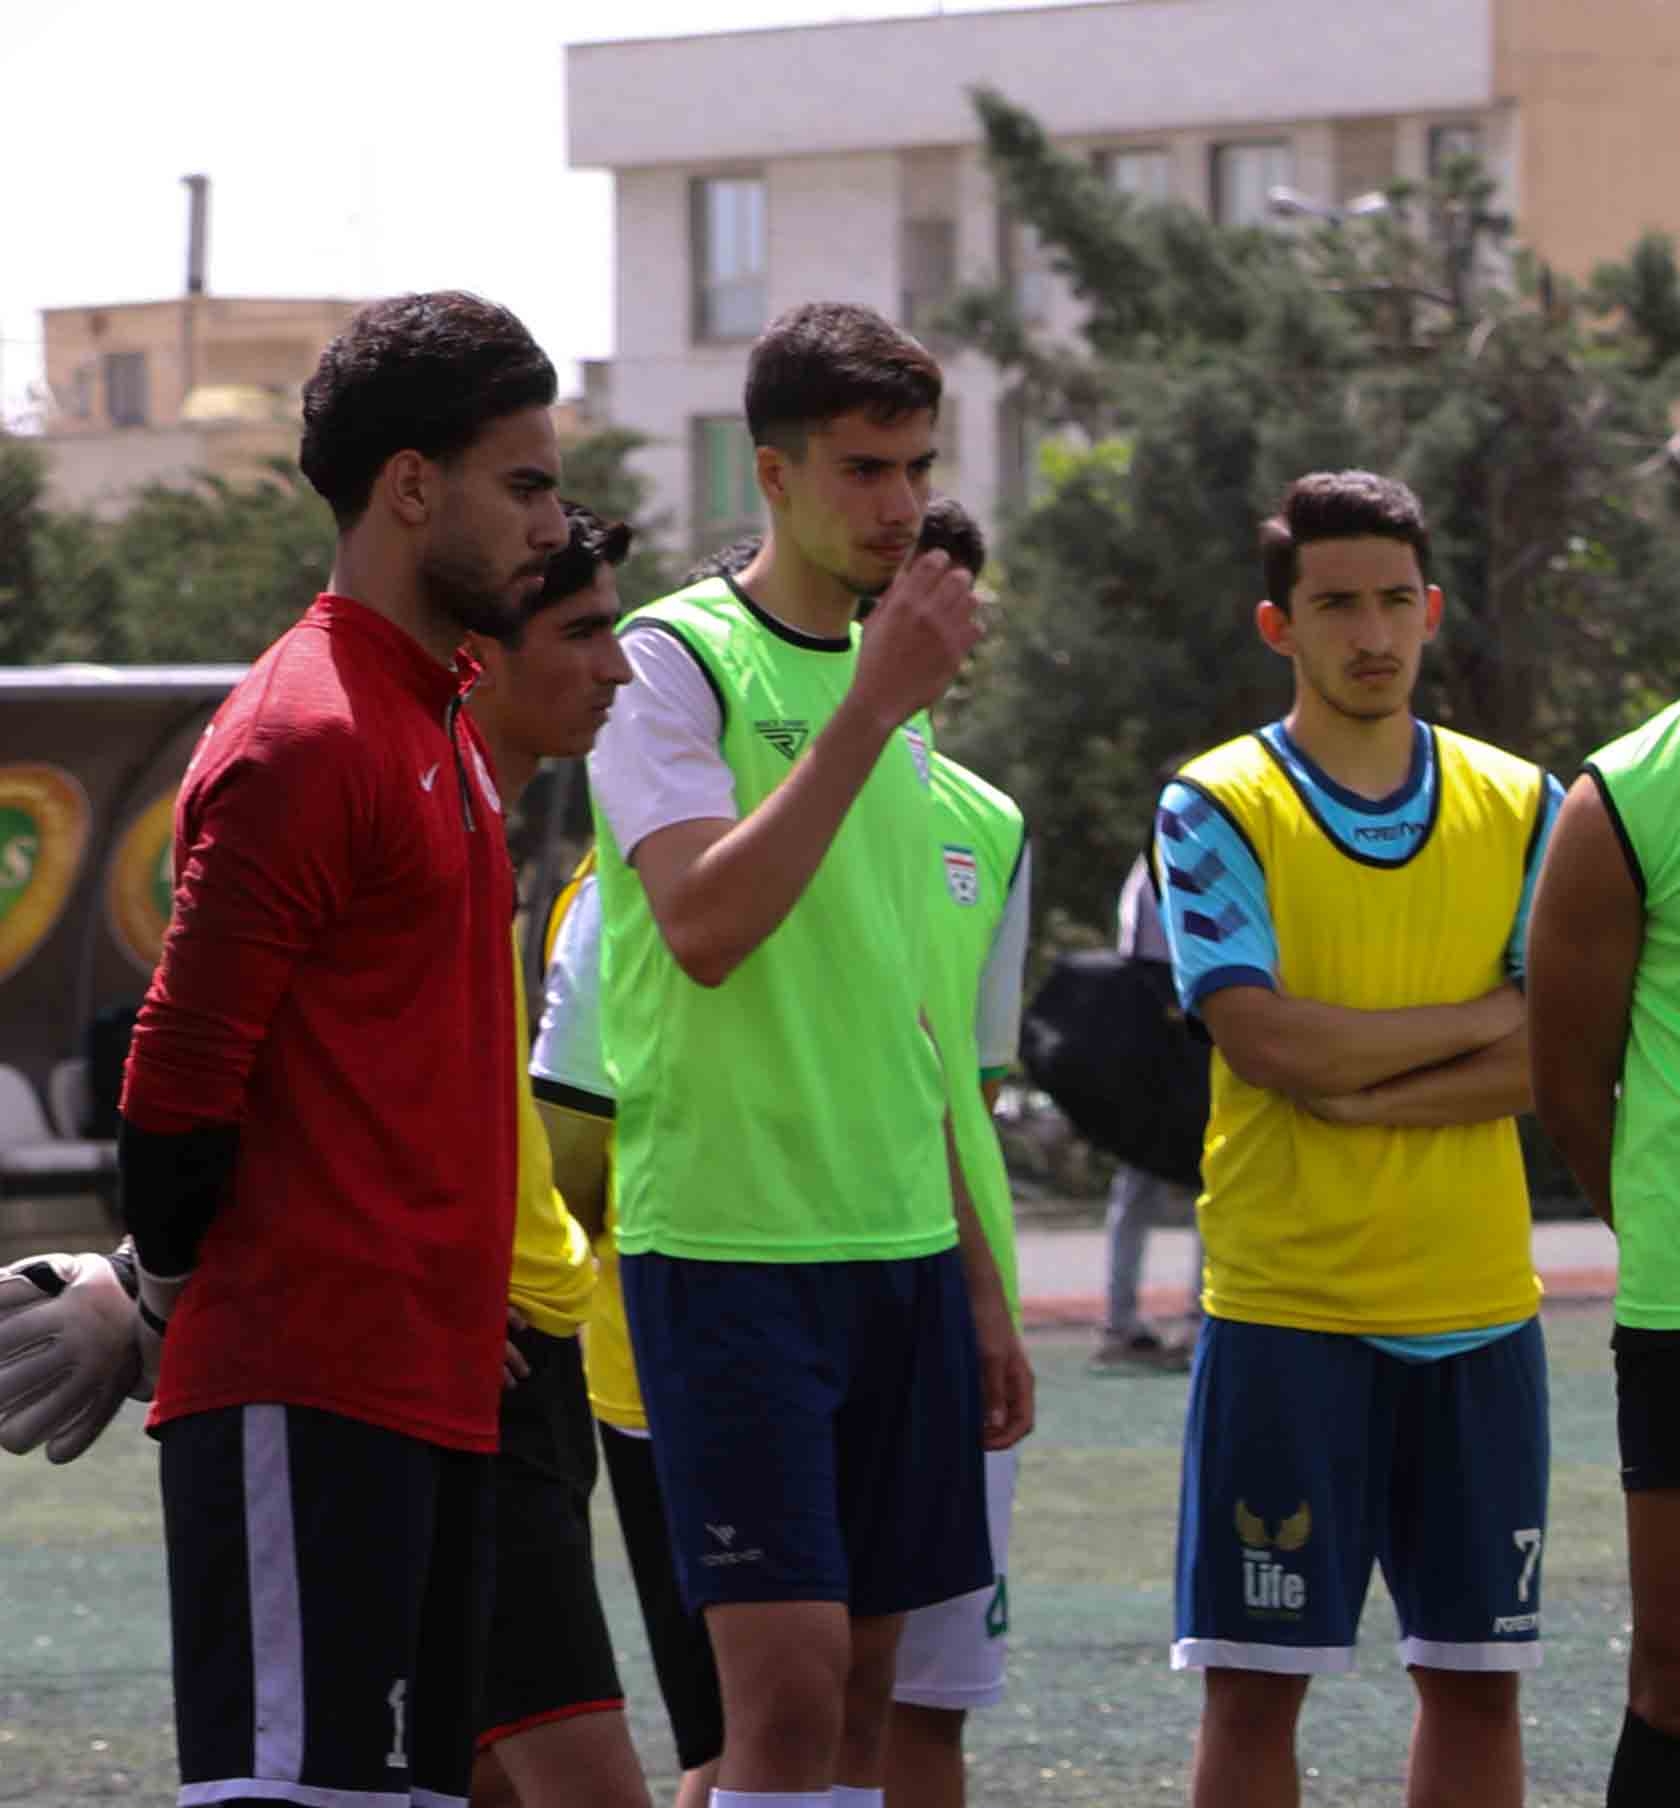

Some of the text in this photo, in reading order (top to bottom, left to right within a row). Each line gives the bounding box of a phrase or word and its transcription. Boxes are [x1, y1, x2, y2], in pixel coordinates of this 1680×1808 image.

[1243, 1561, 1306, 1610] Life
[1513, 1528, 1541, 1602] 7
[386, 1679, 407, 1768] 1
